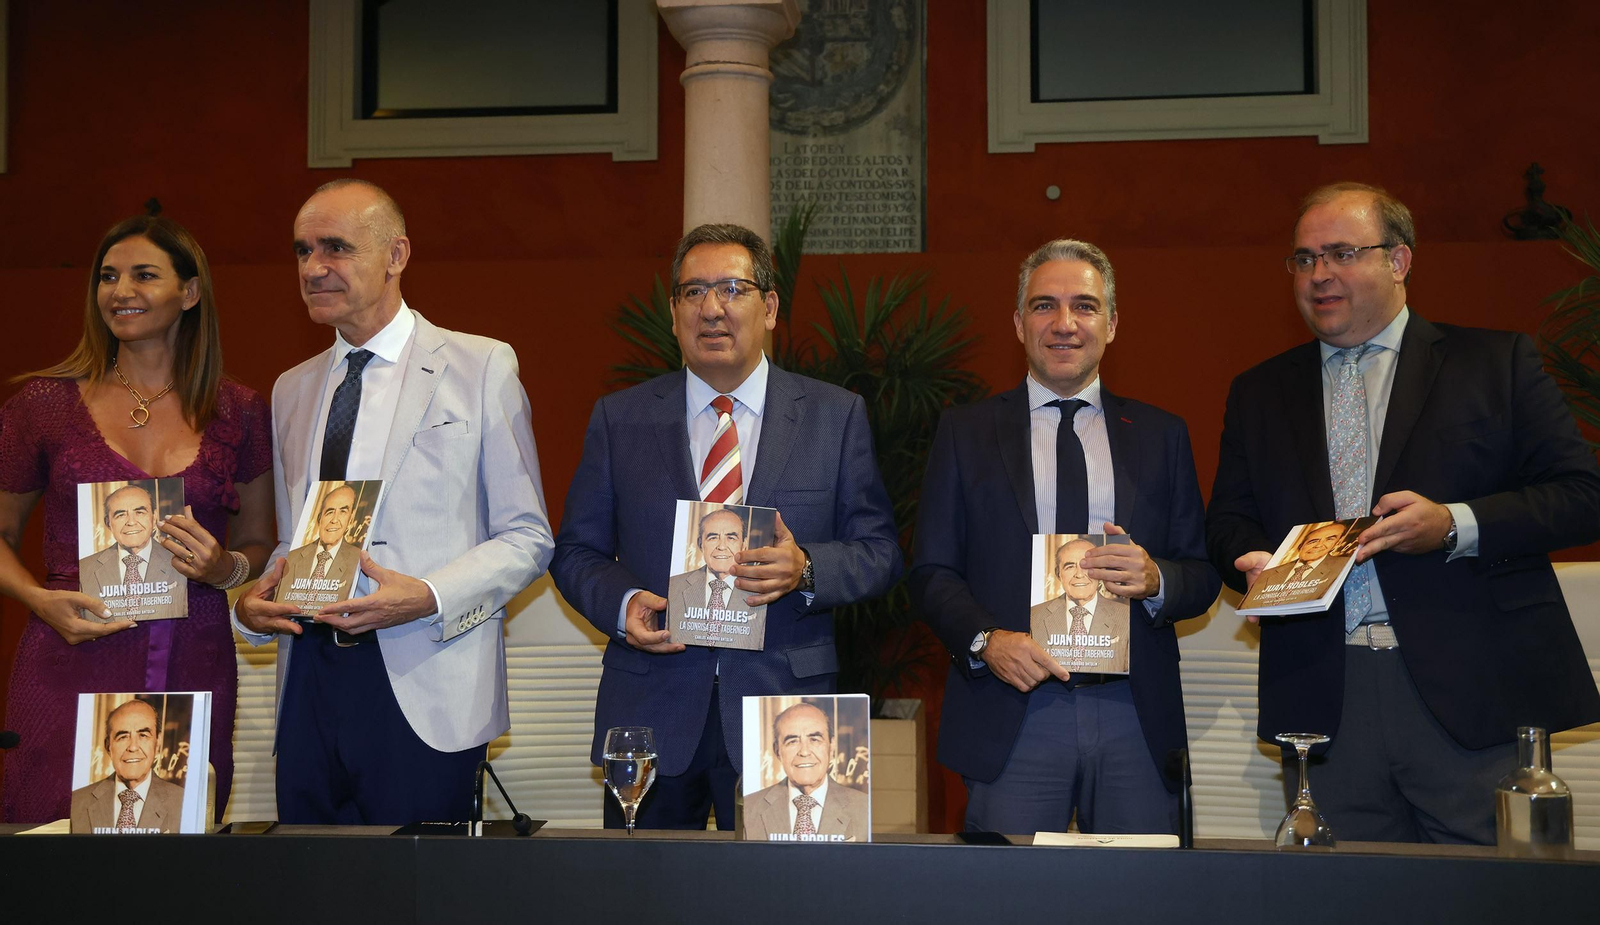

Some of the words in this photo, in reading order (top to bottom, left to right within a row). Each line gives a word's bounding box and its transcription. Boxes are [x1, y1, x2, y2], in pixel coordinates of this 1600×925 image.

[99, 584, 126, 598] JUAN
[130, 581, 168, 594] ROBLES
[290, 578, 311, 590] JUAN
[312, 578, 340, 590] ROBLES
[1262, 582, 1286, 593] JUAN
[1286, 578, 1320, 589] ROBLES
[140, 595, 173, 606] TABERNERO
[684, 606, 710, 620] JUAN
[712, 609, 748, 623] ROBLES
[680, 621, 686, 630] LA
[687, 622, 708, 632] SONRISA
[720, 624, 750, 635] TABERNERO
[1047, 634, 1072, 646] JUAN
[1075, 635, 1111, 647] ROBLES
[1050, 649, 1072, 658] SONRISA
[1085, 649, 1114, 659] TABERNERO
